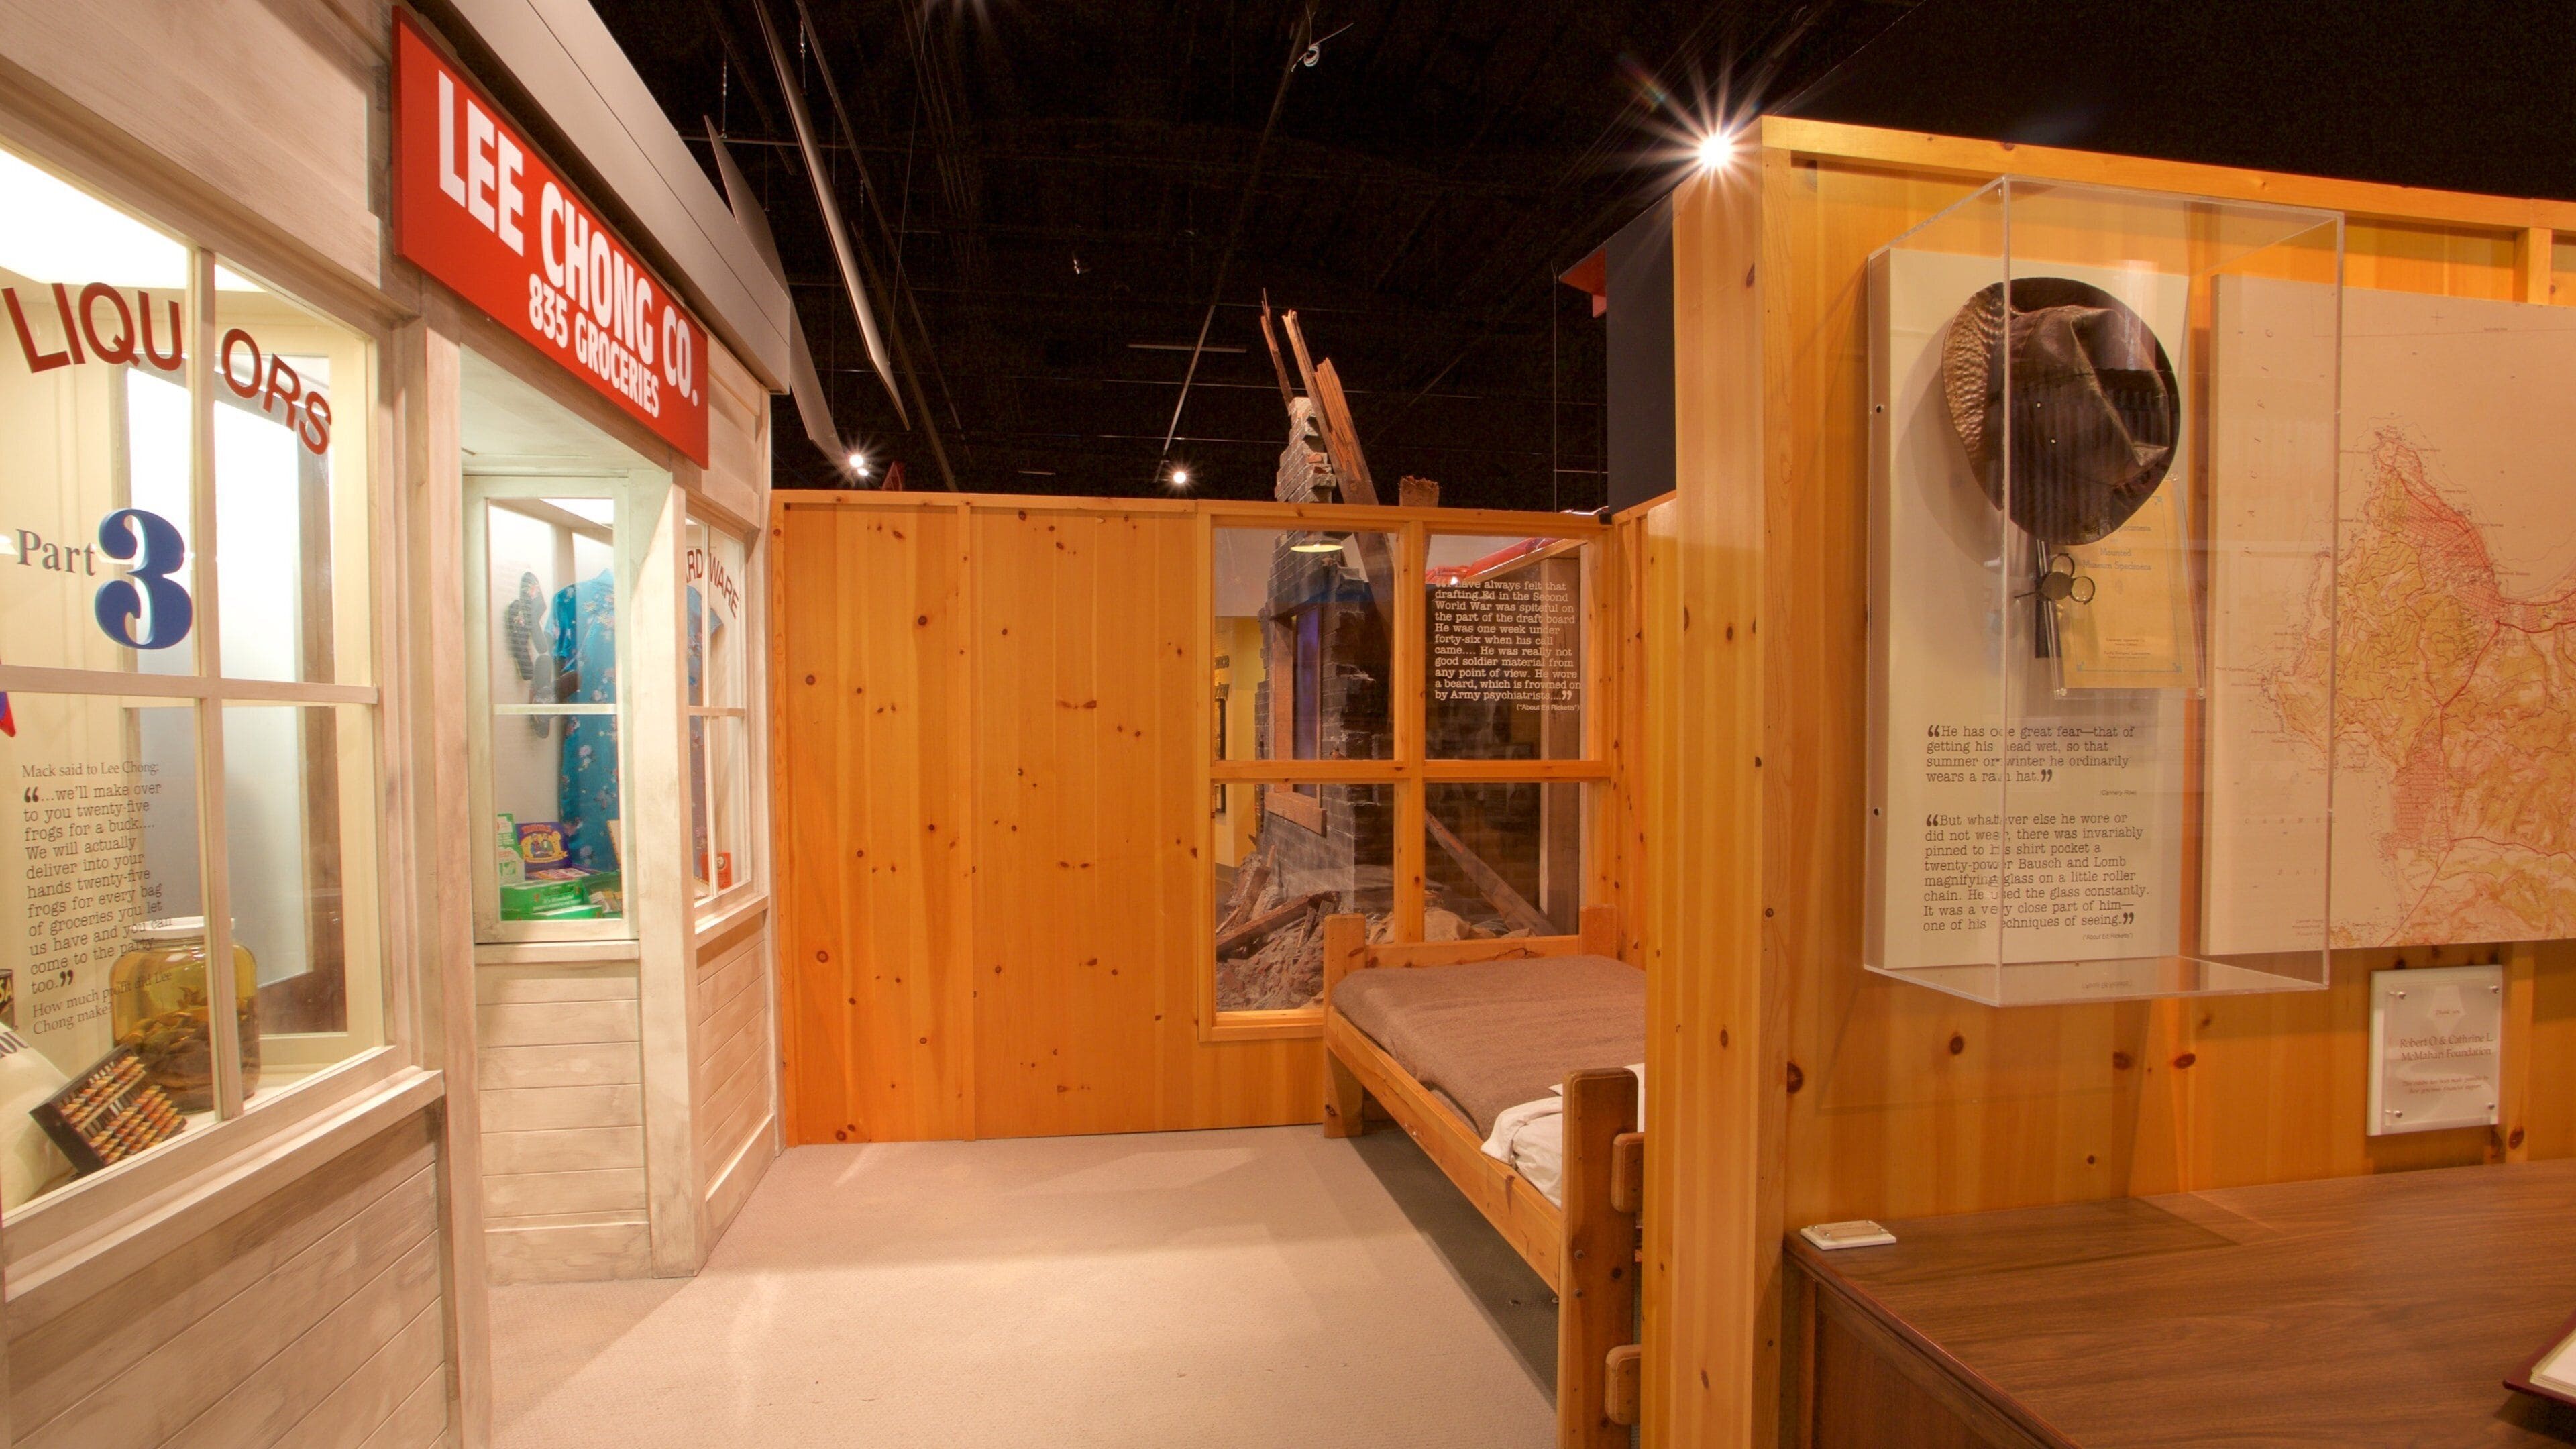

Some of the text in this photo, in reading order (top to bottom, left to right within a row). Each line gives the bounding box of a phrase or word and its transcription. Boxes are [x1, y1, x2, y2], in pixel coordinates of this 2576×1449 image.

[439, 69, 698, 407] LEE CHONG CO.
[529, 273, 660, 419] 835 GROCERIES
[15, 508, 193, 650] Part 3
[1484, 580, 1566, 591] always felt that
[1435, 590, 1568, 602] drafting Ed the Second
[1435, 601, 1466, 610] World
[1470, 602, 1492, 610] War
[1519, 604, 1558, 613] spiteful
[1456, 613, 1479, 623] part
[1517, 614, 1542, 623] draft
[1435, 623, 1449, 632] He
[1500, 625, 1526, 633] week
[1529, 626, 1560, 634] under
[1435, 634, 1553, 645] forty-six when his call
[1522, 647, 1552, 657] really
[1435, 657, 1573, 667] good soldier material from
[1435, 669, 1455, 678] any
[1459, 668, 1486, 678] point
[1504, 669, 1530, 678] view.
[1444, 679, 1566, 690] beard, which frowned
[1450, 690, 1481, 701] Army
[1963, 726, 1984, 737] has
[2021, 727, 2052, 739] great
[1927, 741, 2108, 754] getting wet, that
[22, 761, 159, 777] Mack said to Lee Chong:
[1927, 756, 2129, 768] summer winter ordinarily
[1926, 773, 1964, 782] wears
[93, 784, 129, 798] make
[134, 784, 162, 794] over
[44, 802, 150, 823] you twenty-five
[2033, 814, 2056, 824] else
[2061, 814, 2076, 824] he
[2081, 814, 2109, 823] wore
[25, 826, 63, 842] frogs
[68, 824, 90, 836] for
[1925, 826, 2143, 841] did not there was invariably
[25, 836, 136, 859] We will actually
[1925, 843, 2090, 858] pinned shirt pocket
[26, 854, 144, 879] deliver into your
[2019, 856, 2126, 869] Bausch and Lomb
[28, 869, 150, 899] hands twenty-five
[2004, 874, 2034, 886] glass
[2072, 871, 2098, 882] little
[2103, 871, 2135, 881] roller
[1924, 885, 2149, 901] chain. the glass constantly.
[27, 883, 162, 918] frogs for every bag
[1939, 907, 1962, 916] was
[2018, 902, 2047, 912] close
[2053, 902, 2078, 914] part
[29, 902, 162, 937] of groceries you let
[1968, 919, 1986, 929] his
[29, 918, 172, 956] us have and you can
[30, 938, 154, 975] come to the party
[33, 1001, 63, 1018] How
[67, 989, 98, 1008] much
[103, 980, 131, 1000] profit
[155, 971, 172, 983] Lee
[34, 1002, 113, 1034] Chong make?
[2400, 1038, 2426, 1048] Robert
